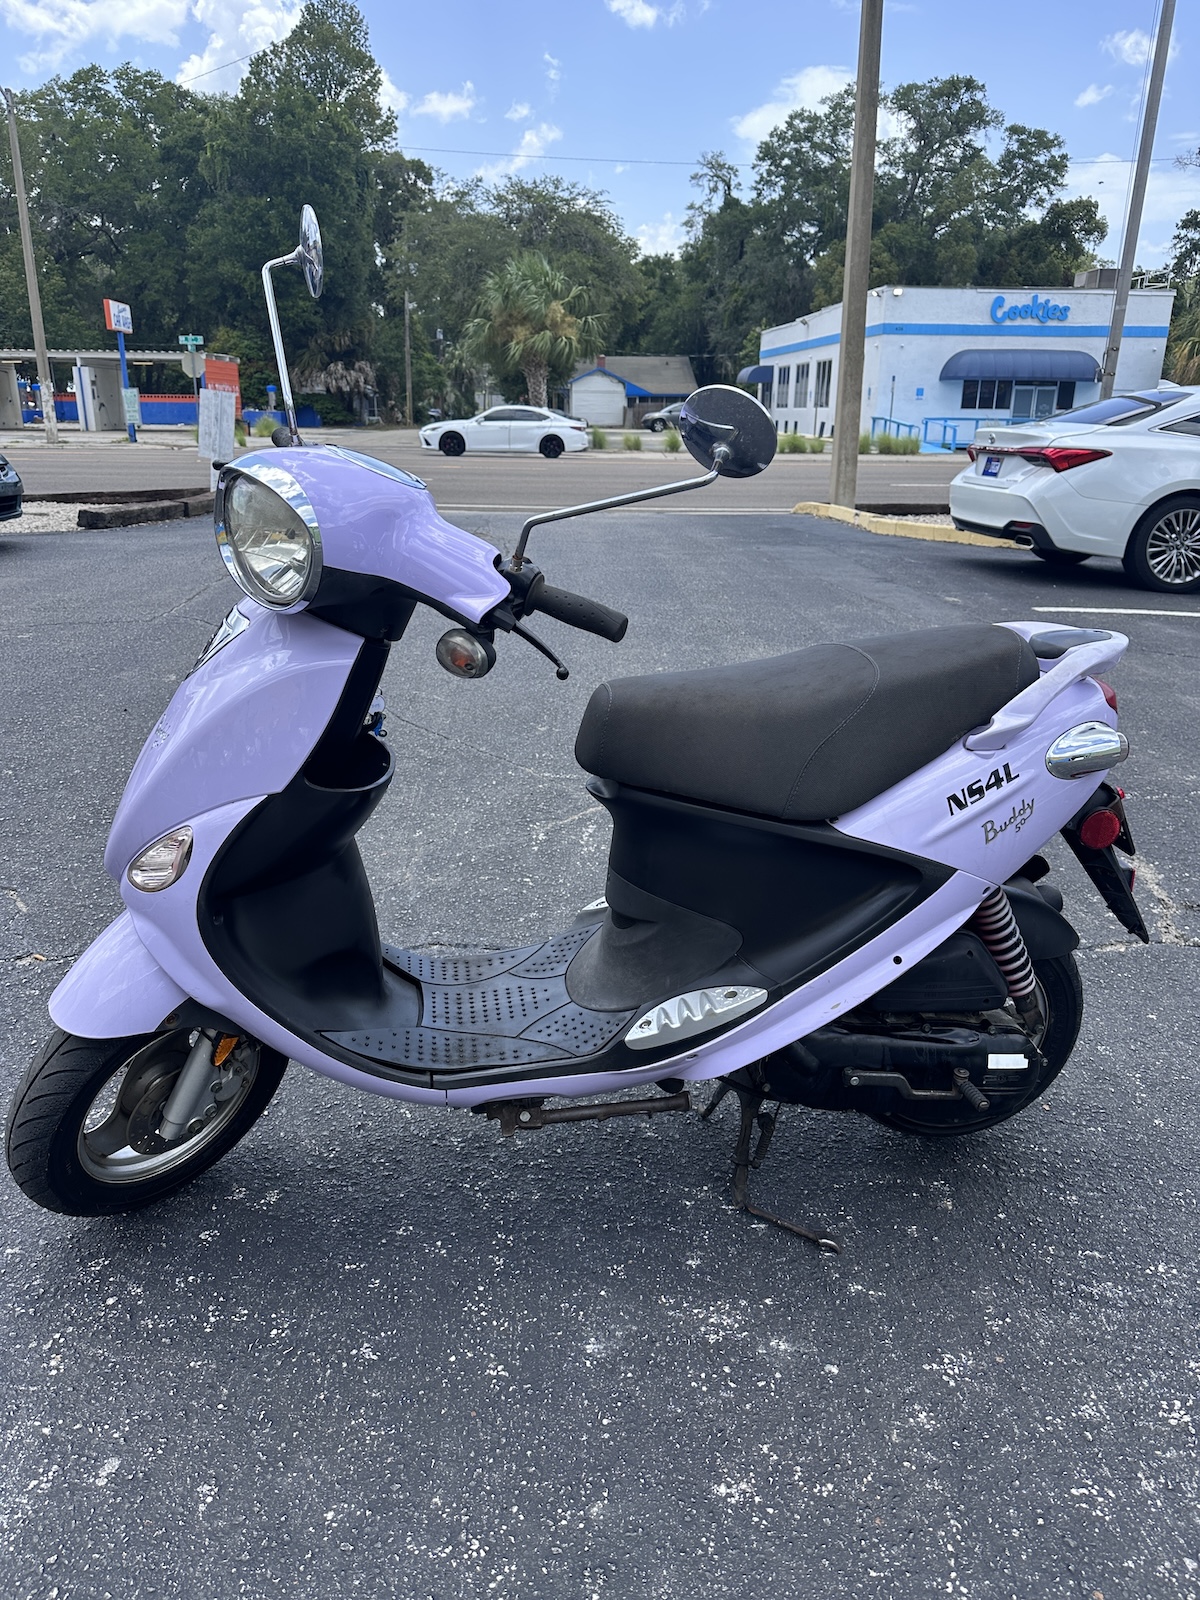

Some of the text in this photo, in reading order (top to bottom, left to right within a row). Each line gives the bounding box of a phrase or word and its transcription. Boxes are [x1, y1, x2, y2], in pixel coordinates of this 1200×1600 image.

[990, 294, 1070, 324] Cookies
[946, 762, 1020, 816] NS4L
[981, 798, 1034, 845] Buddy
[1015, 818, 1026, 833] 50
